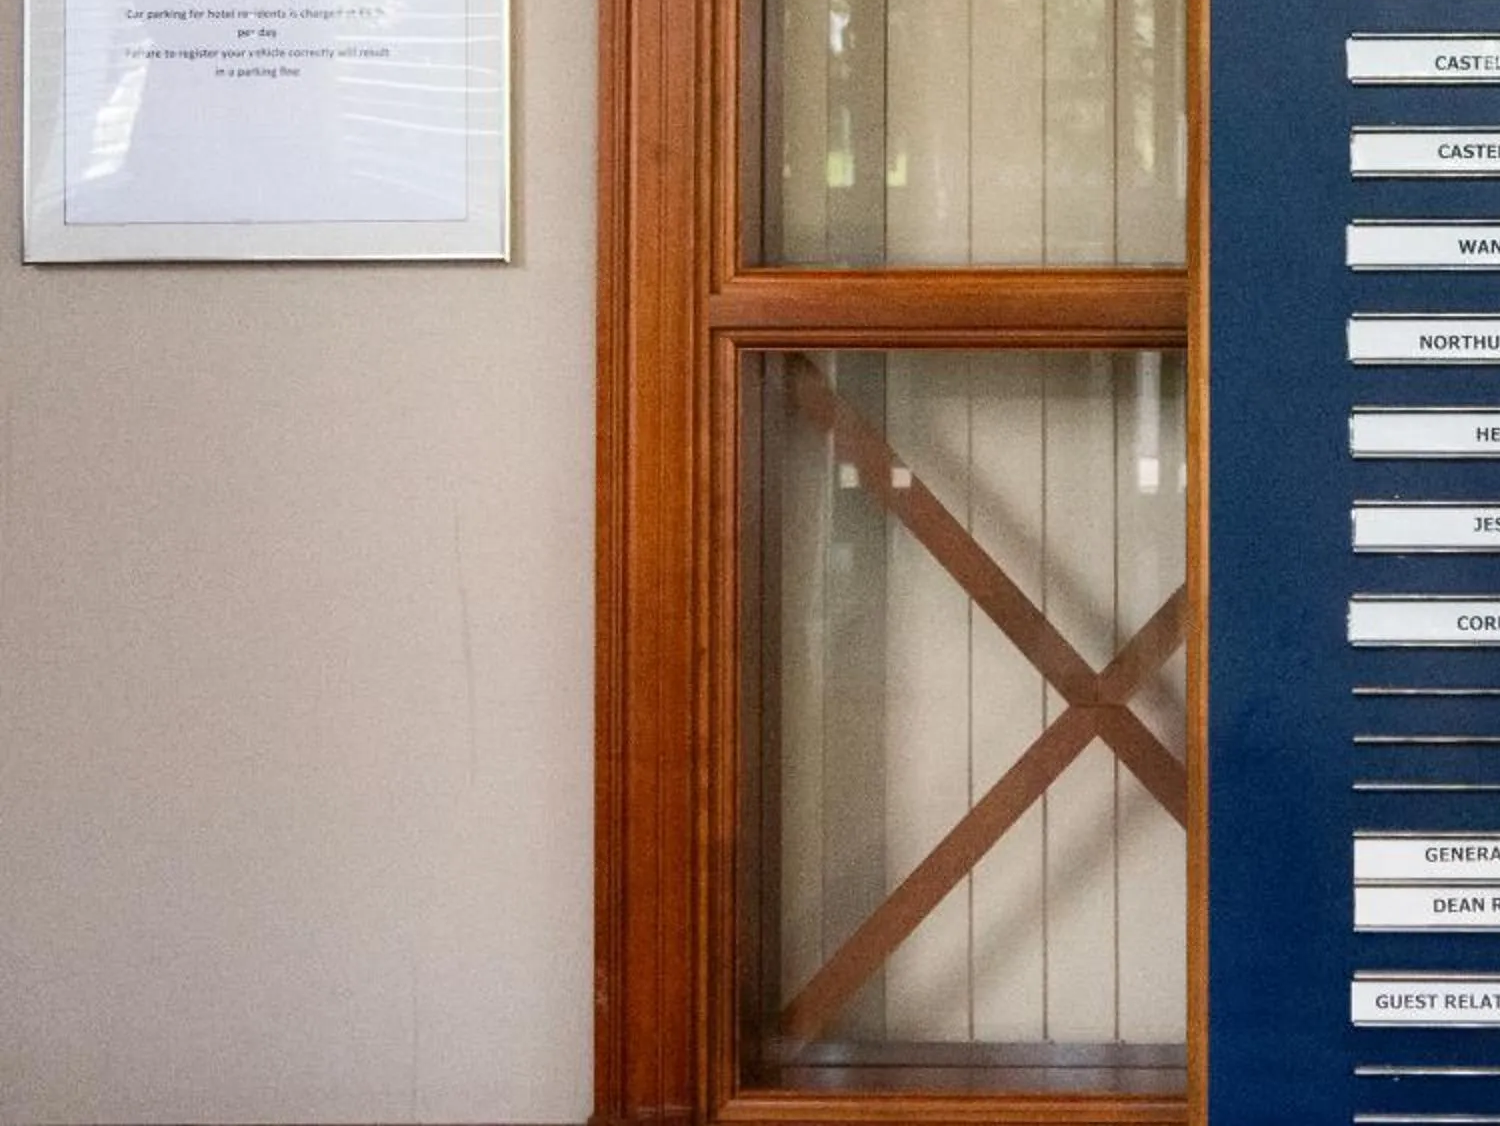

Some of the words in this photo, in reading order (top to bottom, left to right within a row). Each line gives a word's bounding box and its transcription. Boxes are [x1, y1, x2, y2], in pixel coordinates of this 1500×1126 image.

[147, 8, 187, 21] parking
[207, 8, 235, 19] hotel
[258, 27, 277, 39] day
[1432, 896, 1486, 914] DEAN
[1375, 993, 1439, 1010] GUEST
